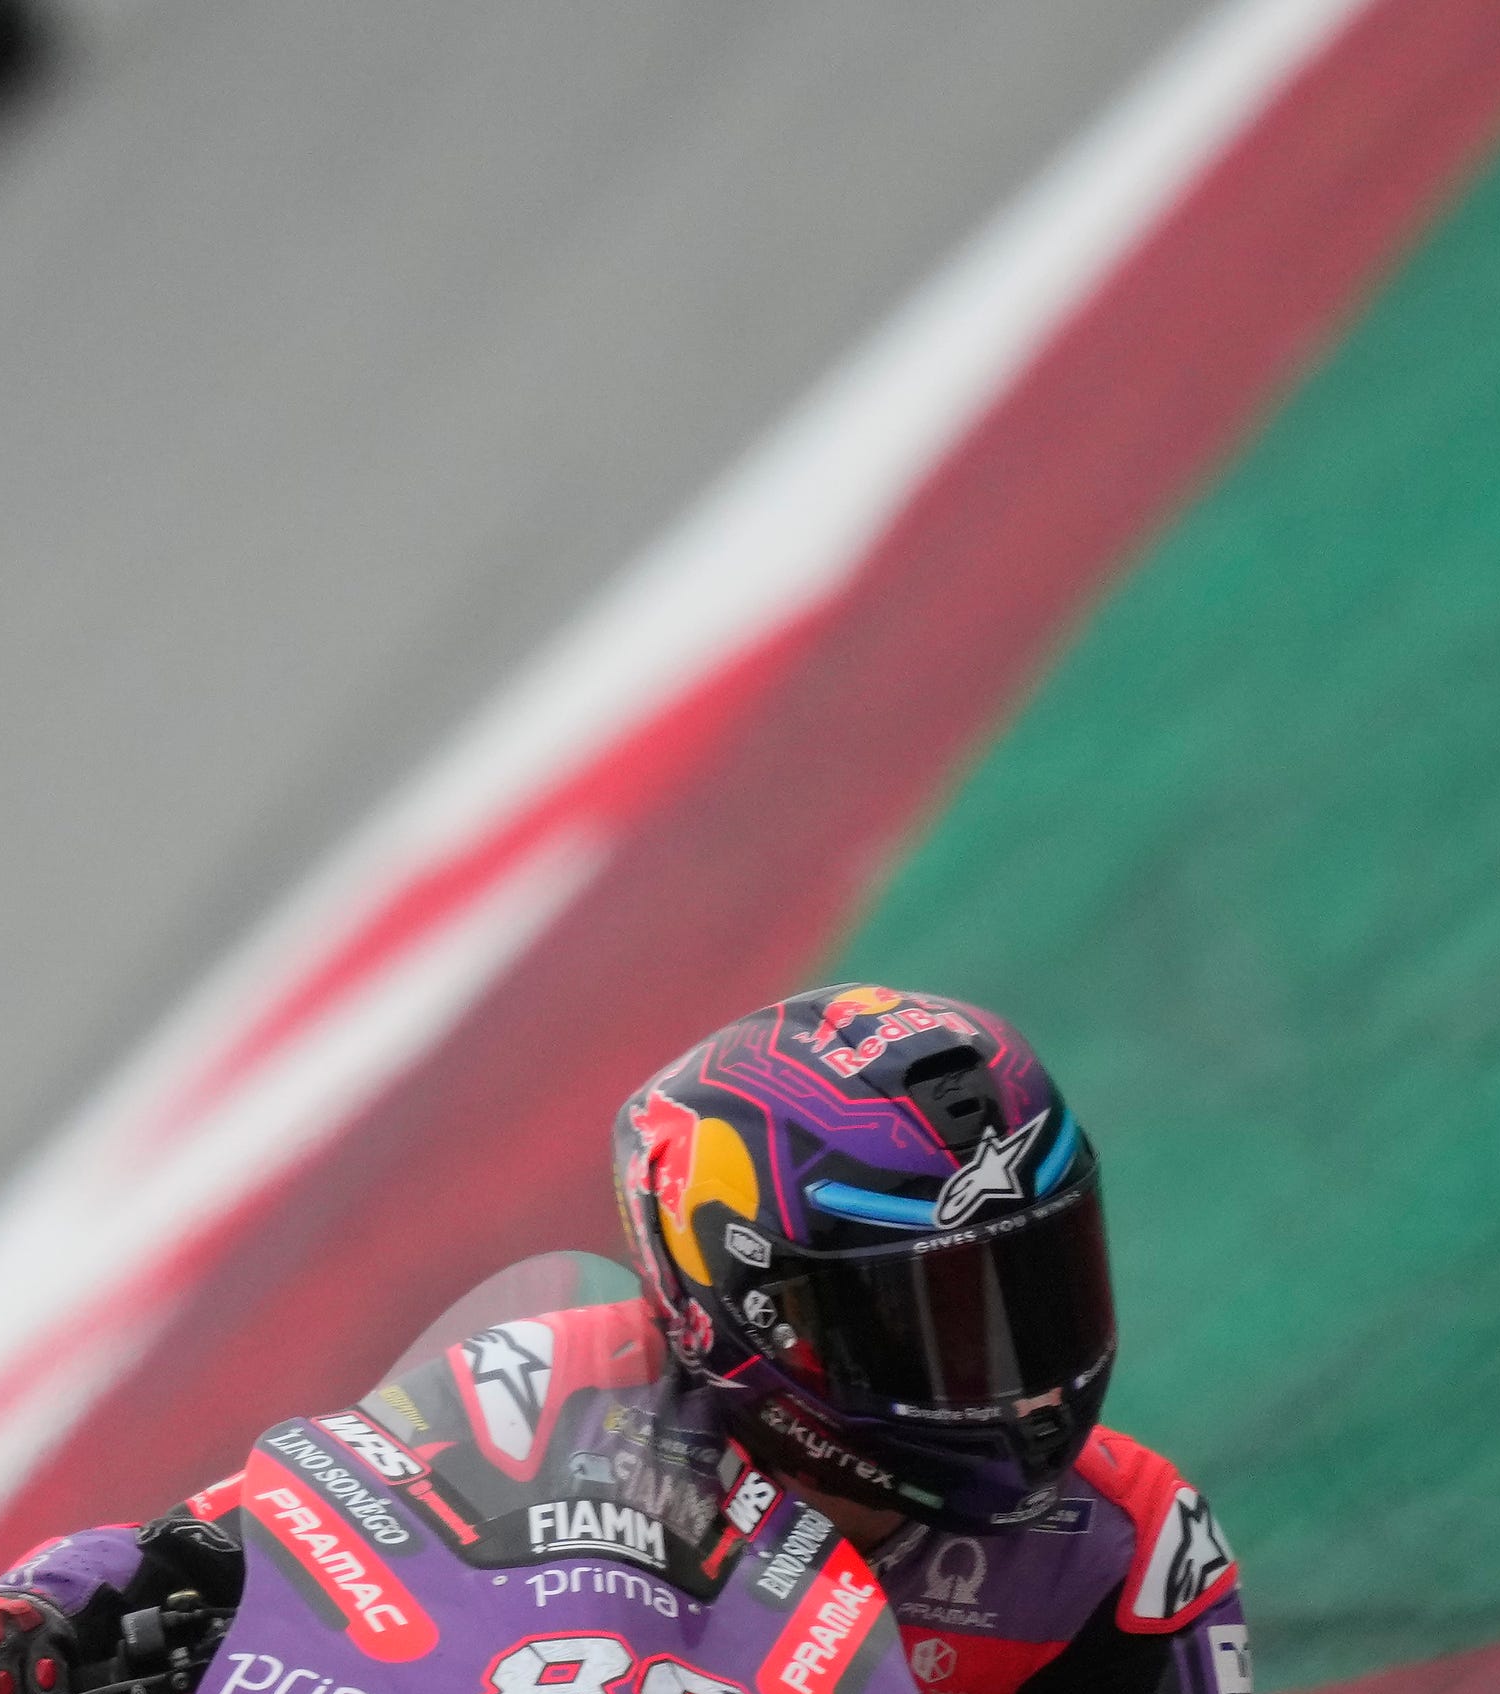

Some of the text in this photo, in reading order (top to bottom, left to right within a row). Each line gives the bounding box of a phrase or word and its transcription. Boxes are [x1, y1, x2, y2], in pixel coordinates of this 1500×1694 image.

[787, 1421, 894, 1488] kyrrex
[255, 1488, 409, 1633] PRAMAC
[529, 1502, 667, 1562] FIAMM
[527, 1566, 679, 1617] prima
